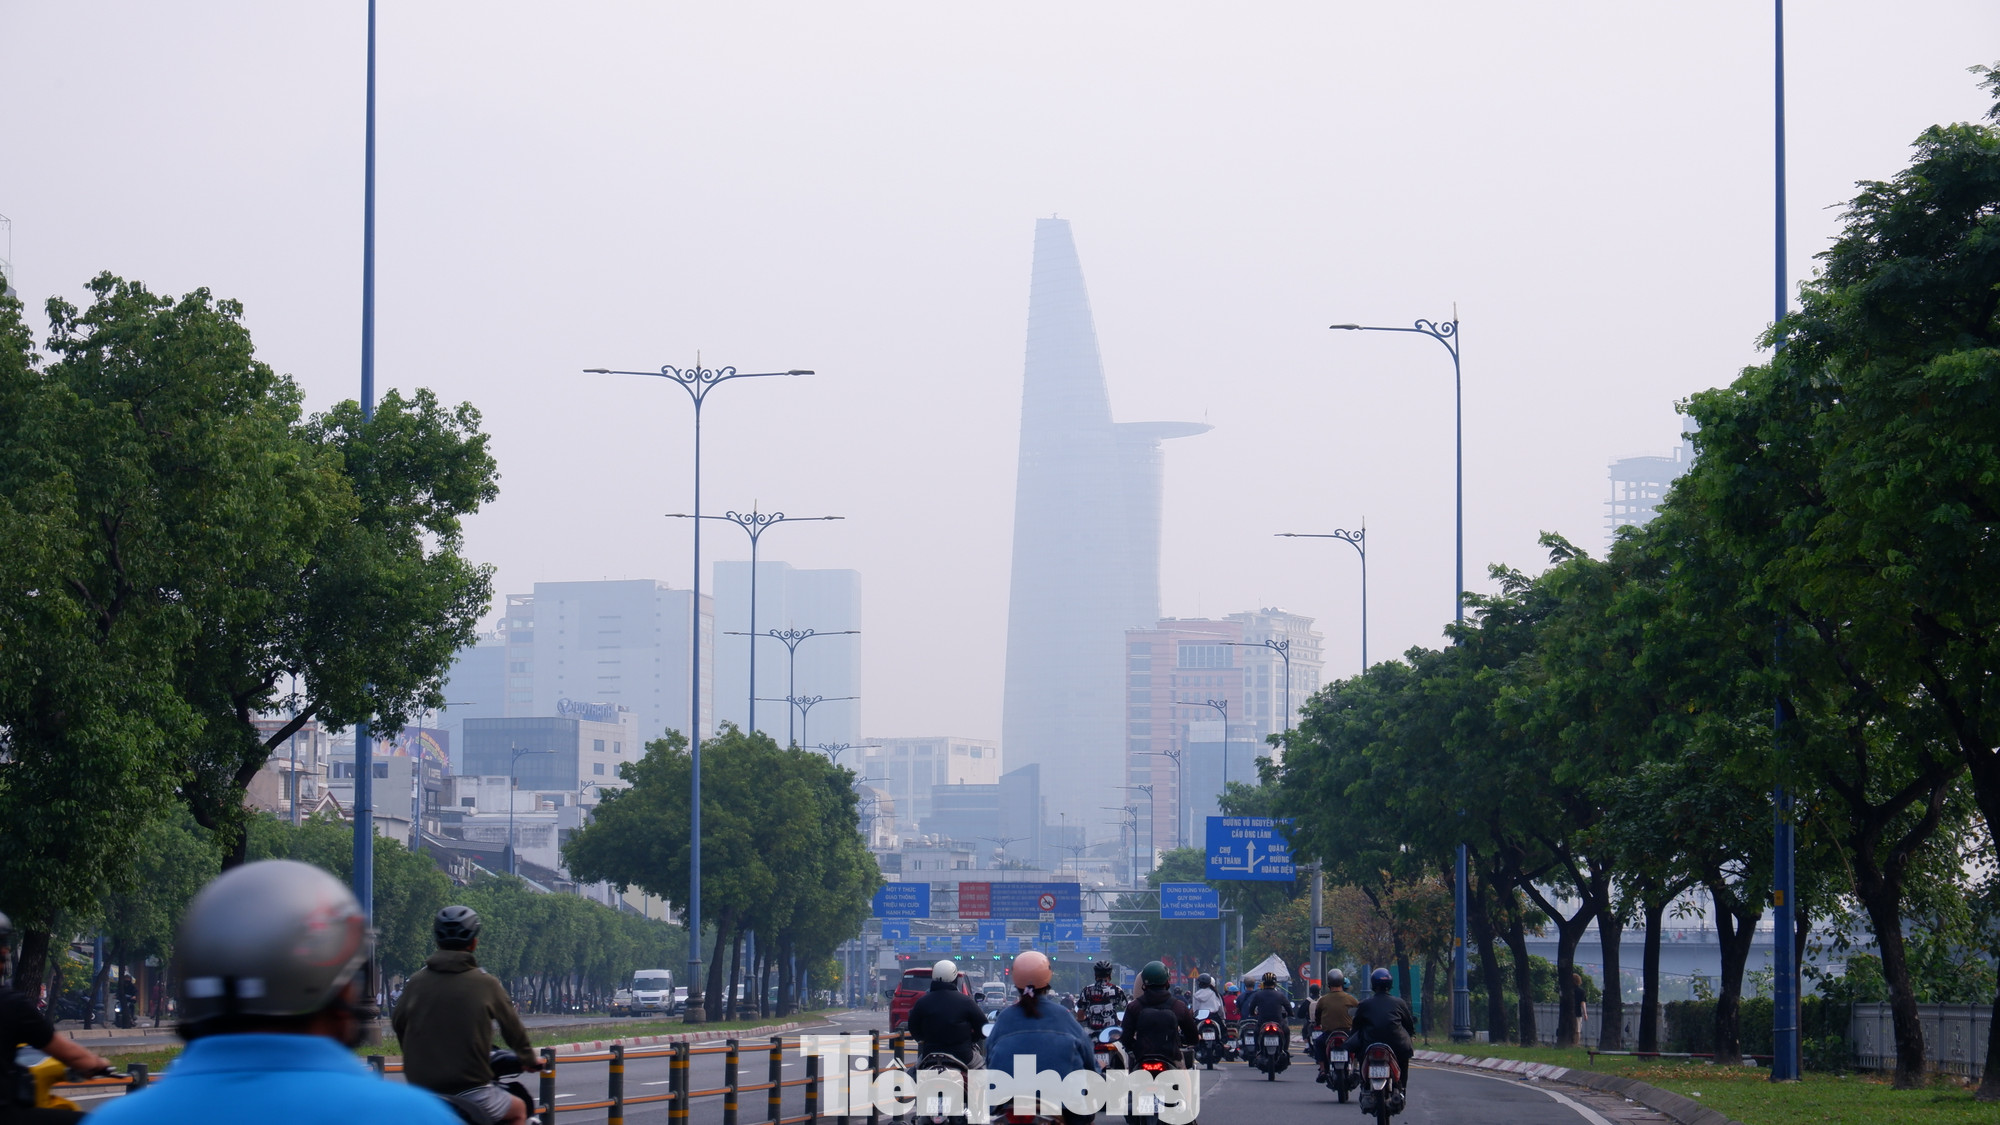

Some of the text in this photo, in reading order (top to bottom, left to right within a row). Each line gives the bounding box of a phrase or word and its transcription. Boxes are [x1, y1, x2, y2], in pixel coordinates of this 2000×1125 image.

[1244, 830, 1256, 838] ÔNG
[1220, 846, 1231, 855] CHỢ
[1211, 855, 1241, 864] BẾN THÀNH
[1261, 864, 1279, 874] HOÀNG
